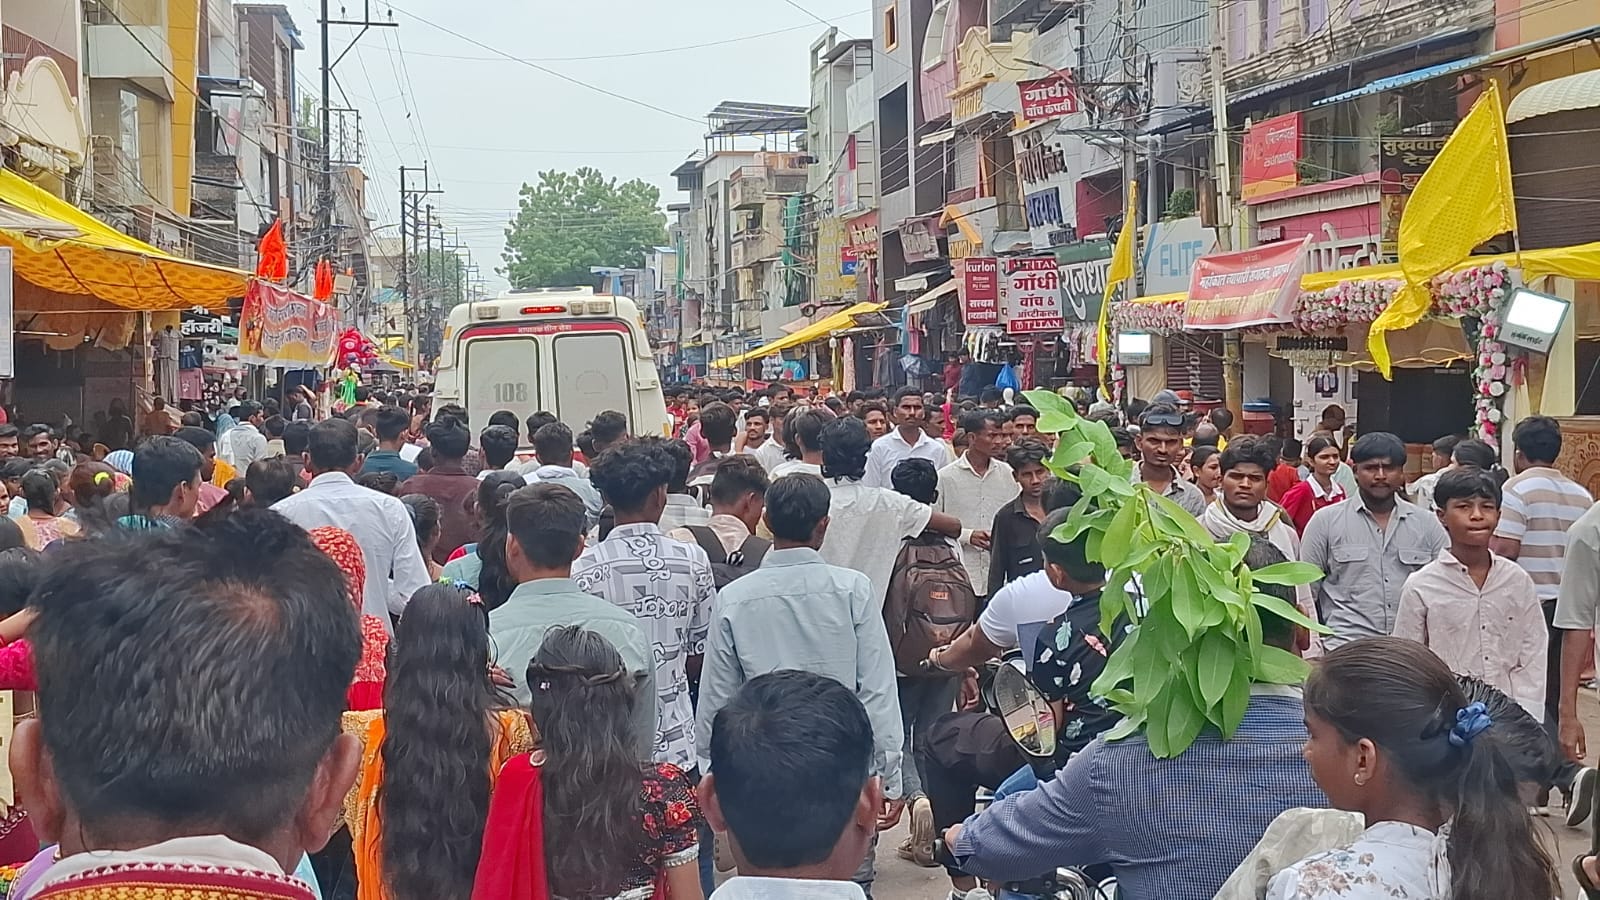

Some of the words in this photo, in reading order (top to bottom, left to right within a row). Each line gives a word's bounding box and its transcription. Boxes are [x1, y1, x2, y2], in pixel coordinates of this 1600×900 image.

[966, 260, 996, 273] kurlon
[1047, 295, 1055, 306] &
[1025, 319, 1060, 330] TITAN
[493, 382, 528, 403] 108
